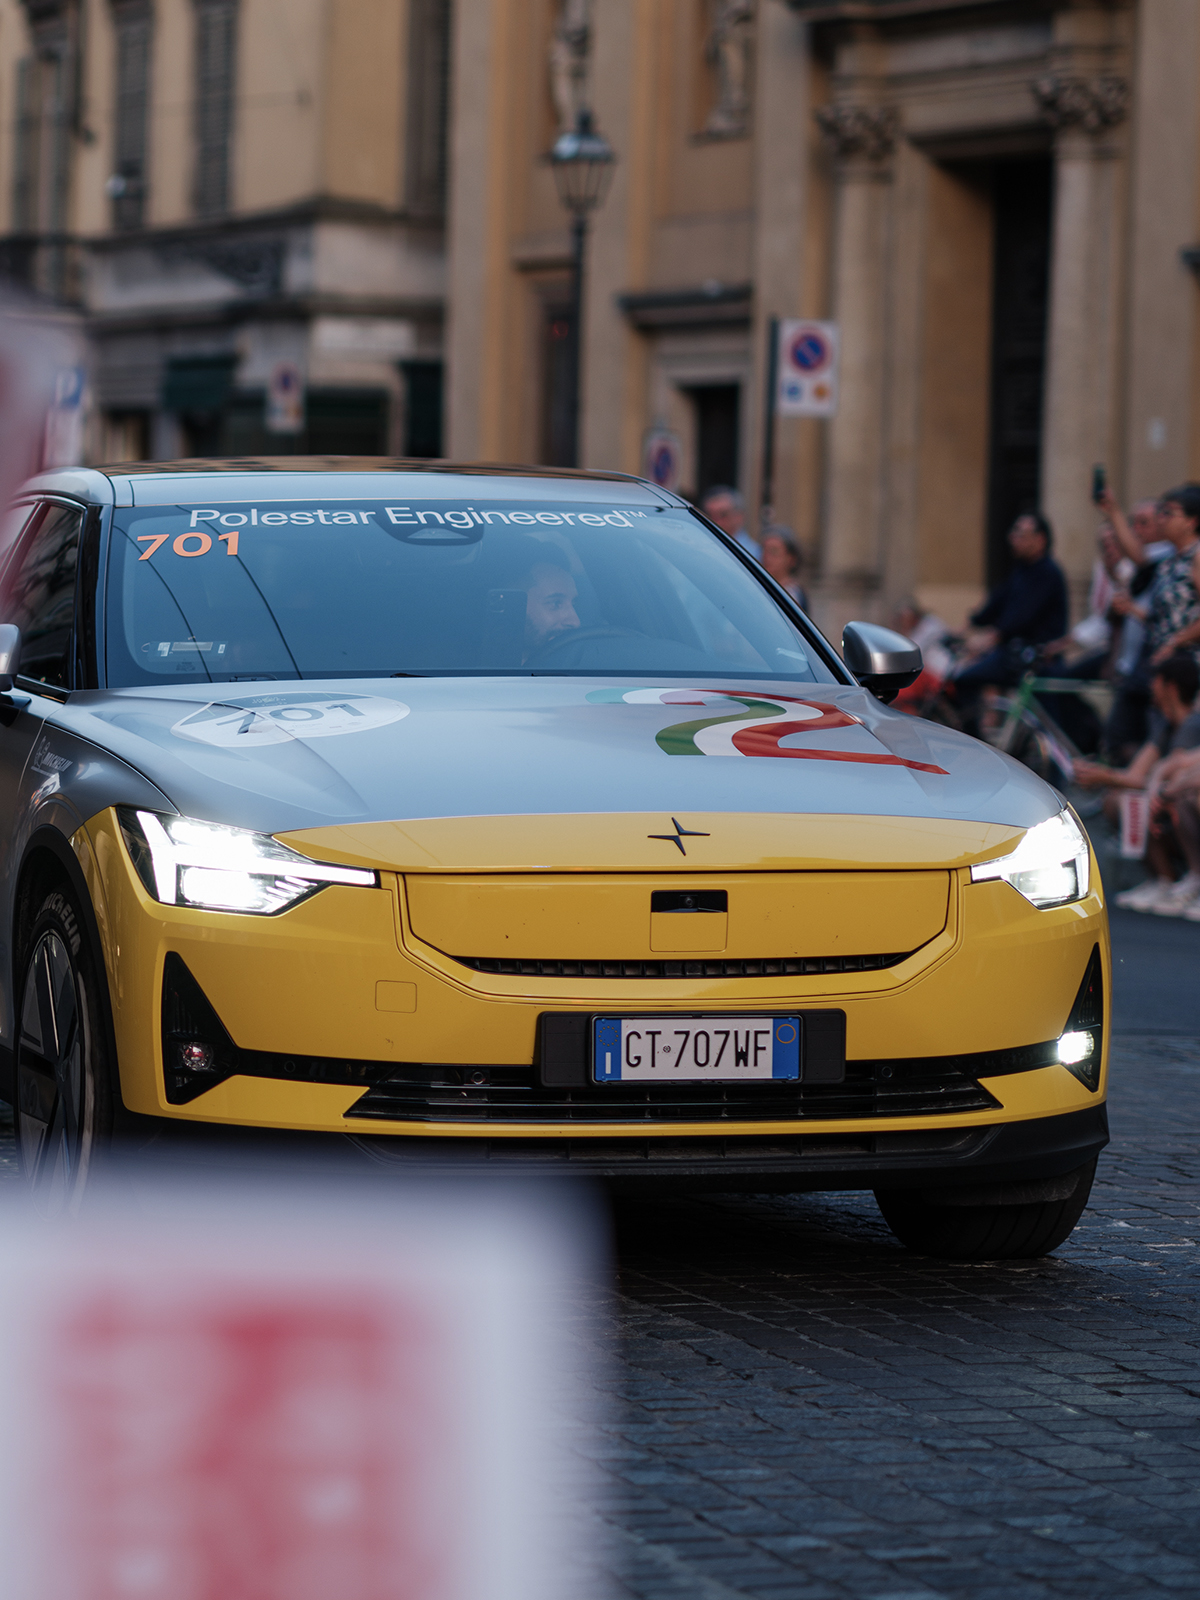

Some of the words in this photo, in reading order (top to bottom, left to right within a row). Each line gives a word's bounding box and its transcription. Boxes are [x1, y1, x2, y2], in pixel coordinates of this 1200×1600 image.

[189, 508, 376, 528] Polestar
[136, 531, 240, 561] 701
[215, 703, 367, 736] 701
